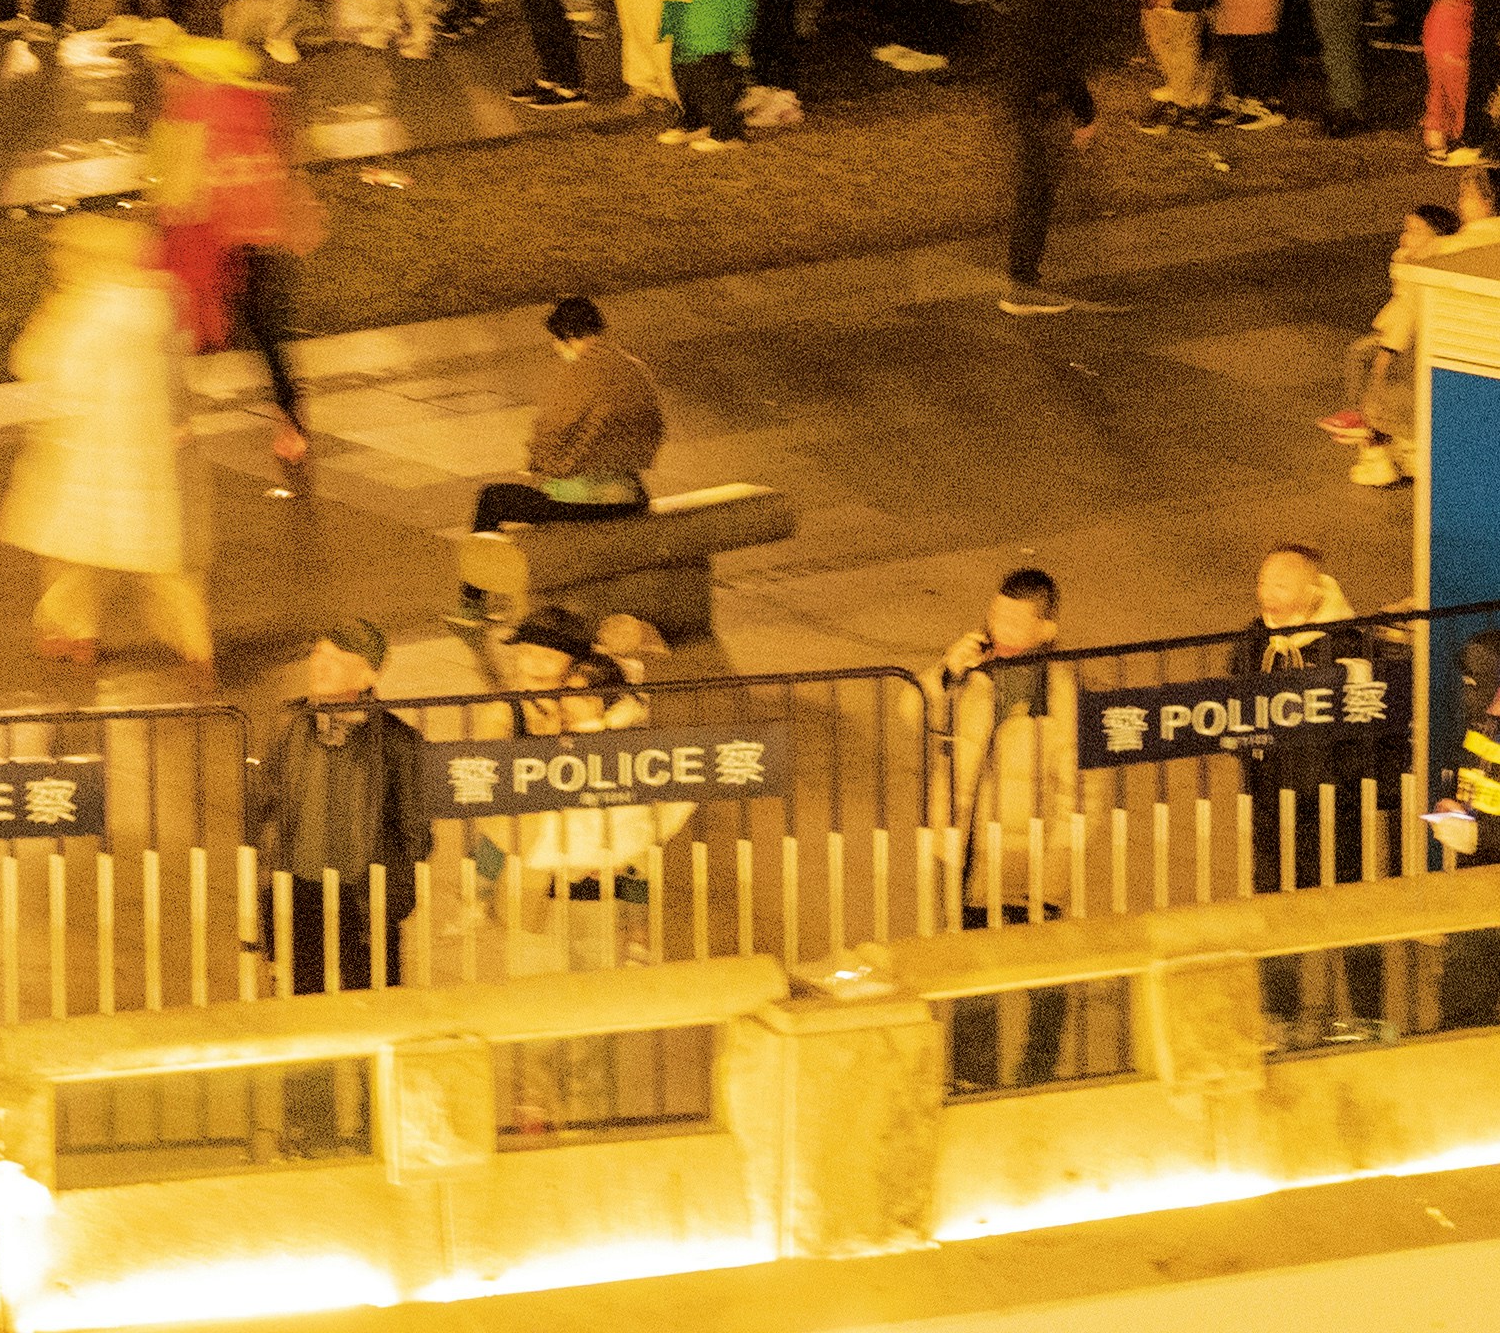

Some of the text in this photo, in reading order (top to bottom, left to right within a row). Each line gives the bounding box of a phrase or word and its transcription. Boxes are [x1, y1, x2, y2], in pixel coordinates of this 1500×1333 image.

[1101, 705, 1148, 753] 警
[1160, 688, 1335, 741] POLICE
[25, 777, 77, 823] 察
[448, 739, 765, 804] 警 POLICE 察
